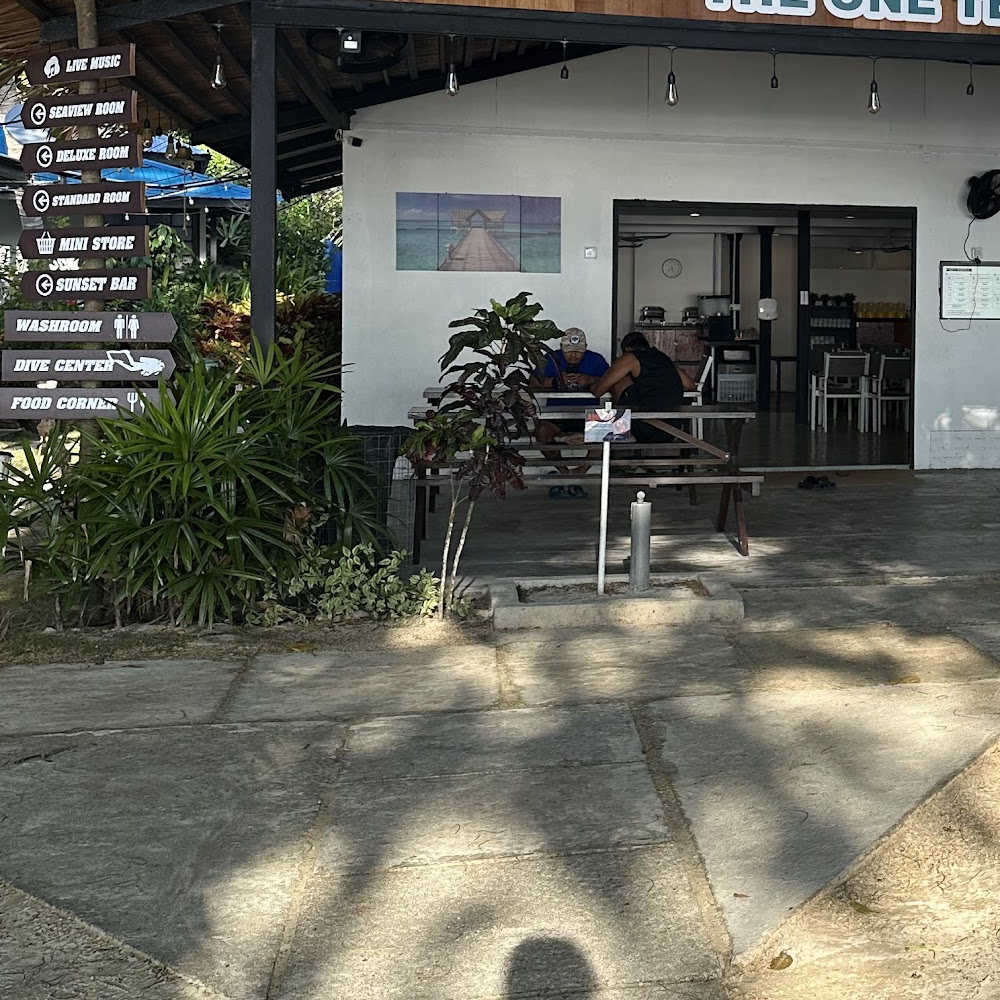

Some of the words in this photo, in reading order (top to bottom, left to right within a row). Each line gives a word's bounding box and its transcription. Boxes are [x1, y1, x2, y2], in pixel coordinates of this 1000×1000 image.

[65, 57, 88, 73] LIVE
[89, 54, 122, 70] MUSIC
[48, 103, 94, 119] SEAVIEW
[94, 100, 125, 116] ROOM
[55, 147, 97, 163] DELUXE
[98, 145, 130, 161] ROOM
[51, 192, 101, 207] STANDARD
[102, 190, 131, 204] ROOM
[58, 236, 88, 252] MINI
[91, 235, 136, 251] STORE
[55, 276, 107, 292] SUNSET
[109, 276, 138, 291] BAR
[15, 318, 103, 333] WASHROOM
[13, 359, 51, 372] DIVE
[54, 359, 114, 372] CENTER
[10, 396, 52, 410] FOOD
[56, 396, 119, 410] CORNER
